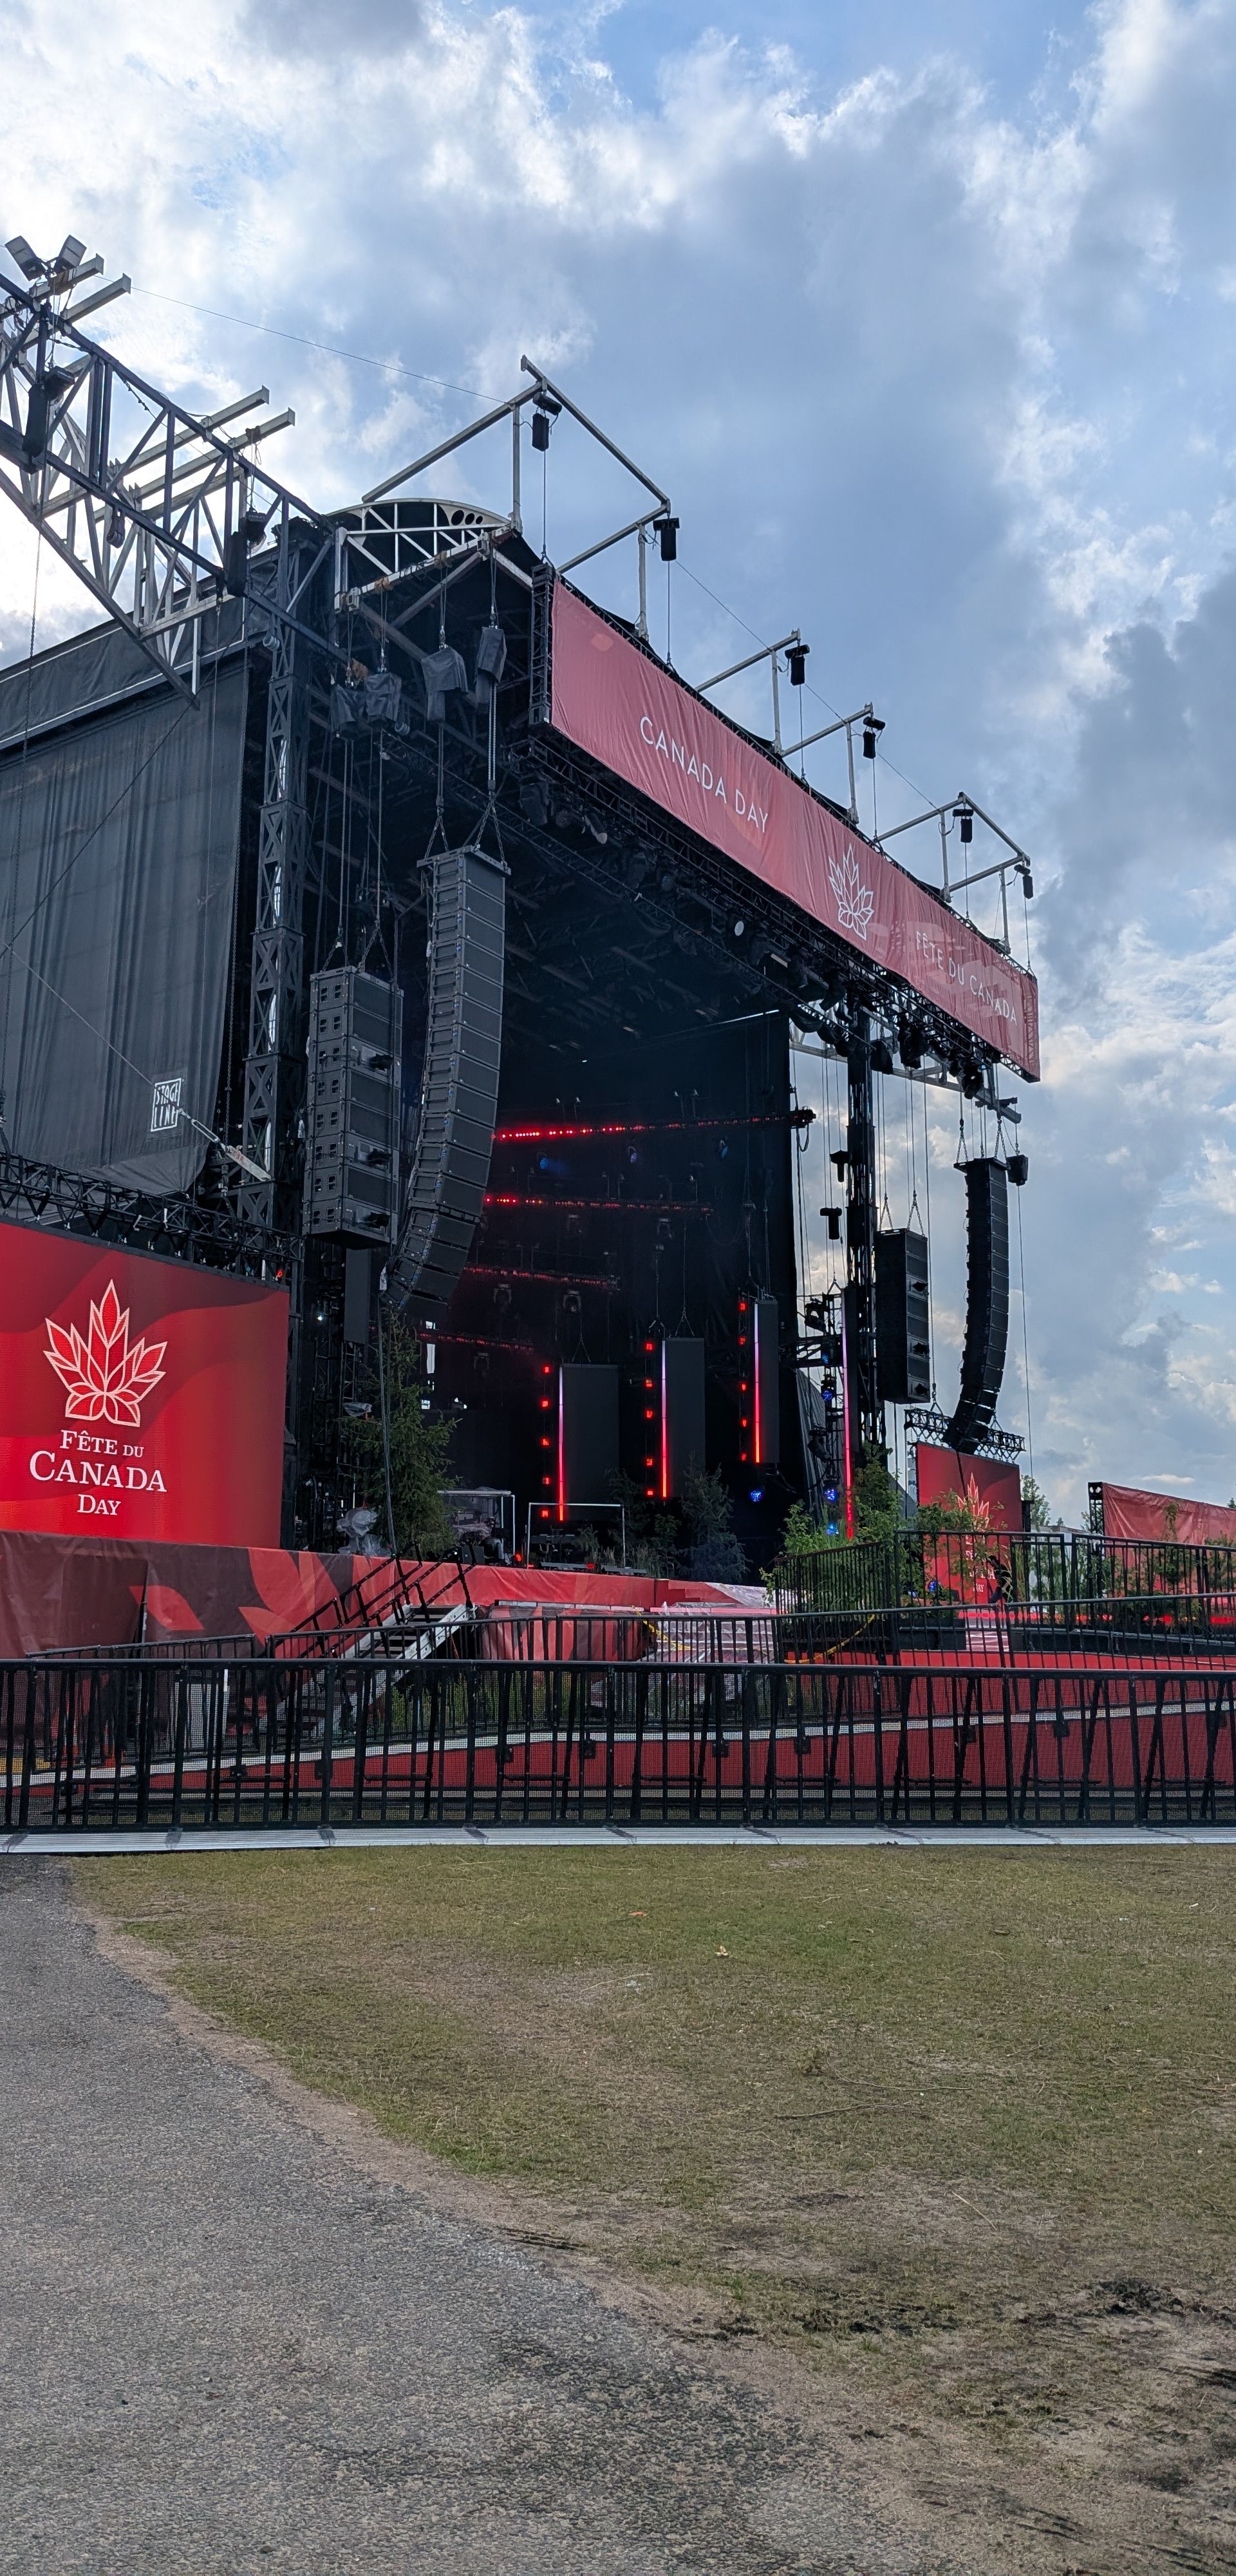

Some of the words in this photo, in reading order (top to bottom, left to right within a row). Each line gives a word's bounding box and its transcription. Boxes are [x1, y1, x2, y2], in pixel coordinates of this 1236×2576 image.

[640, 716, 727, 804] CANADA
[735, 789, 768, 833] DAY
[917, 931, 944, 971] FÊTE
[949, 958, 964, 985] DU
[969, 975, 1017, 1026] CANADA
[156, 1083, 178, 1104] STAGE
[154, 1104, 176, 1128] LINE
[60, 1430, 118, 1455] FÊTE
[122, 1444, 144, 1458] DU
[30, 1450, 167, 1492] CANADA
[77, 1493, 122, 1515] DAY
